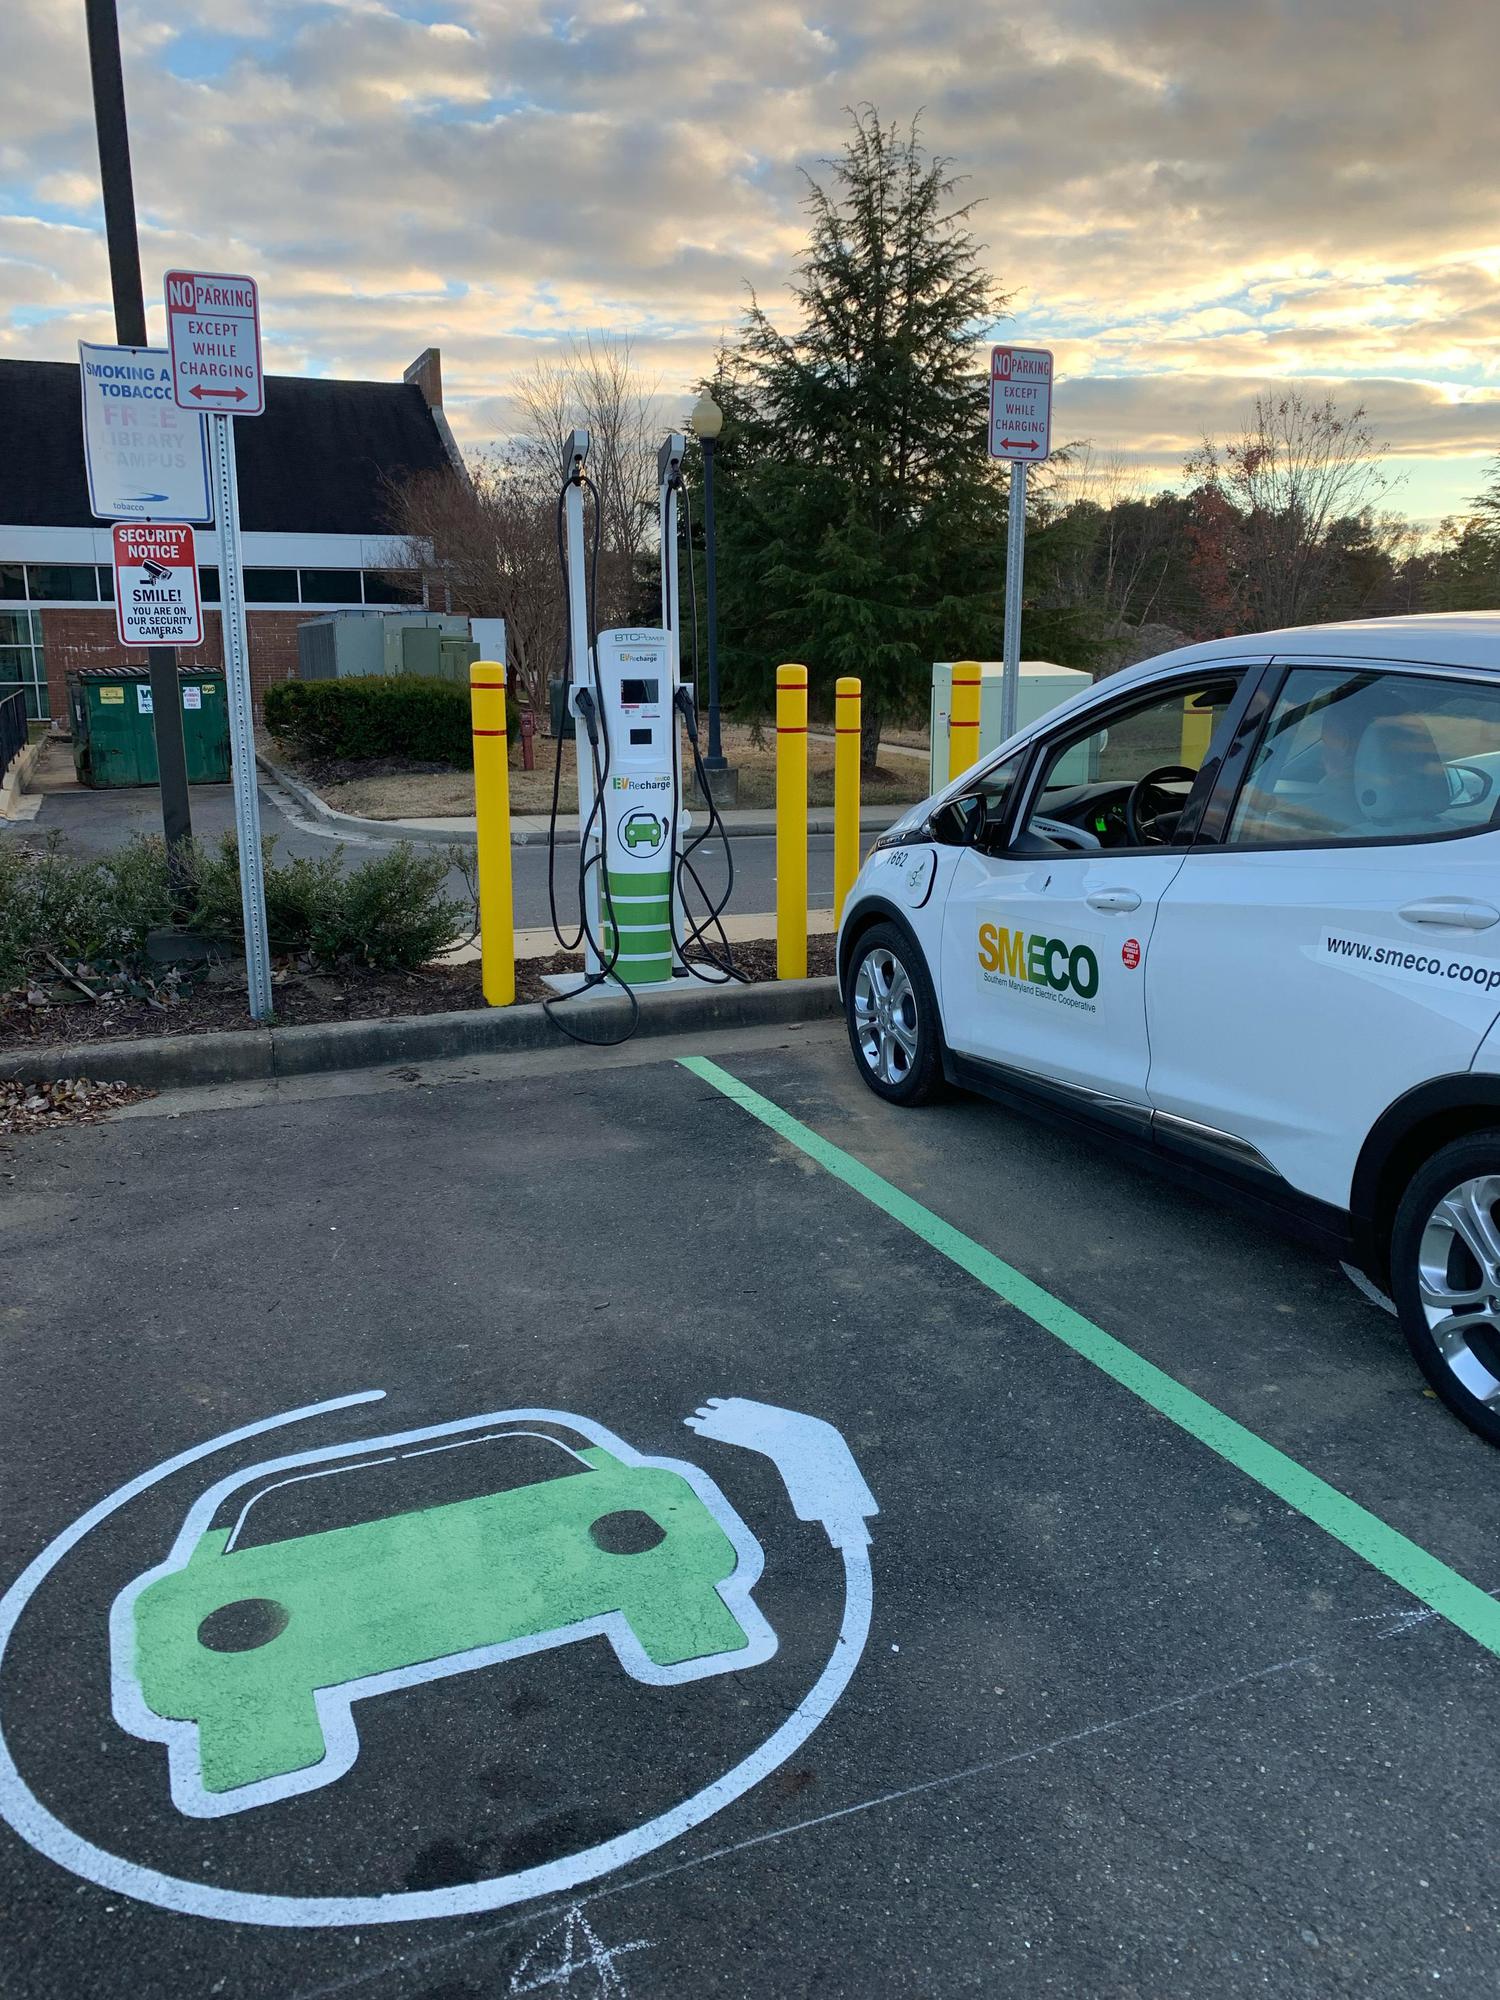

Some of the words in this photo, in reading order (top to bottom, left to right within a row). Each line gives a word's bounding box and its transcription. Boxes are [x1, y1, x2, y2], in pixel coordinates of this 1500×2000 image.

[168, 280, 195, 308] NO
[196, 286, 253, 309] PARKING
[188, 321, 238, 337] EXCEPT
[193, 343, 237, 358] WHILE
[86, 362, 155, 381] SMOKING
[180, 361, 254, 379] CHARGING
[994, 354, 1010, 376] NO
[1012, 358, 1049, 375] PARKING
[1004, 386, 1038, 399] EXCEPT
[1006, 403, 1036, 416] WHILE
[995, 418, 1045, 433] CHARGING
[101, 432, 185, 449] LIBRARY
[104, 451, 187, 469] CAMPUS
[113, 502, 145, 512] tobacco
[119, 529, 186, 543] SECURITY
[128, 545, 180, 559] NOTICE
[133, 590, 182, 601] SMILE!
[133, 607, 151, 615] YOU
[153, 607, 171, 615] ARE
[174, 607, 187, 615] ON
[127, 617, 146, 625] OUR
[149, 617, 193, 625] SECURITY
[139, 626, 183, 635] CAMERAS
[886, 851, 909, 868] 1662
[978, 922, 1099, 999] SMECO
[1327, 936, 1500, 992] www.smeco.coop
[983, 971, 1008, 988] Southern
[1008, 979, 1034, 996] Maryland
[1035, 986, 1057, 1003] Electric
[1057, 993, 1097, 1014] Cooperative
